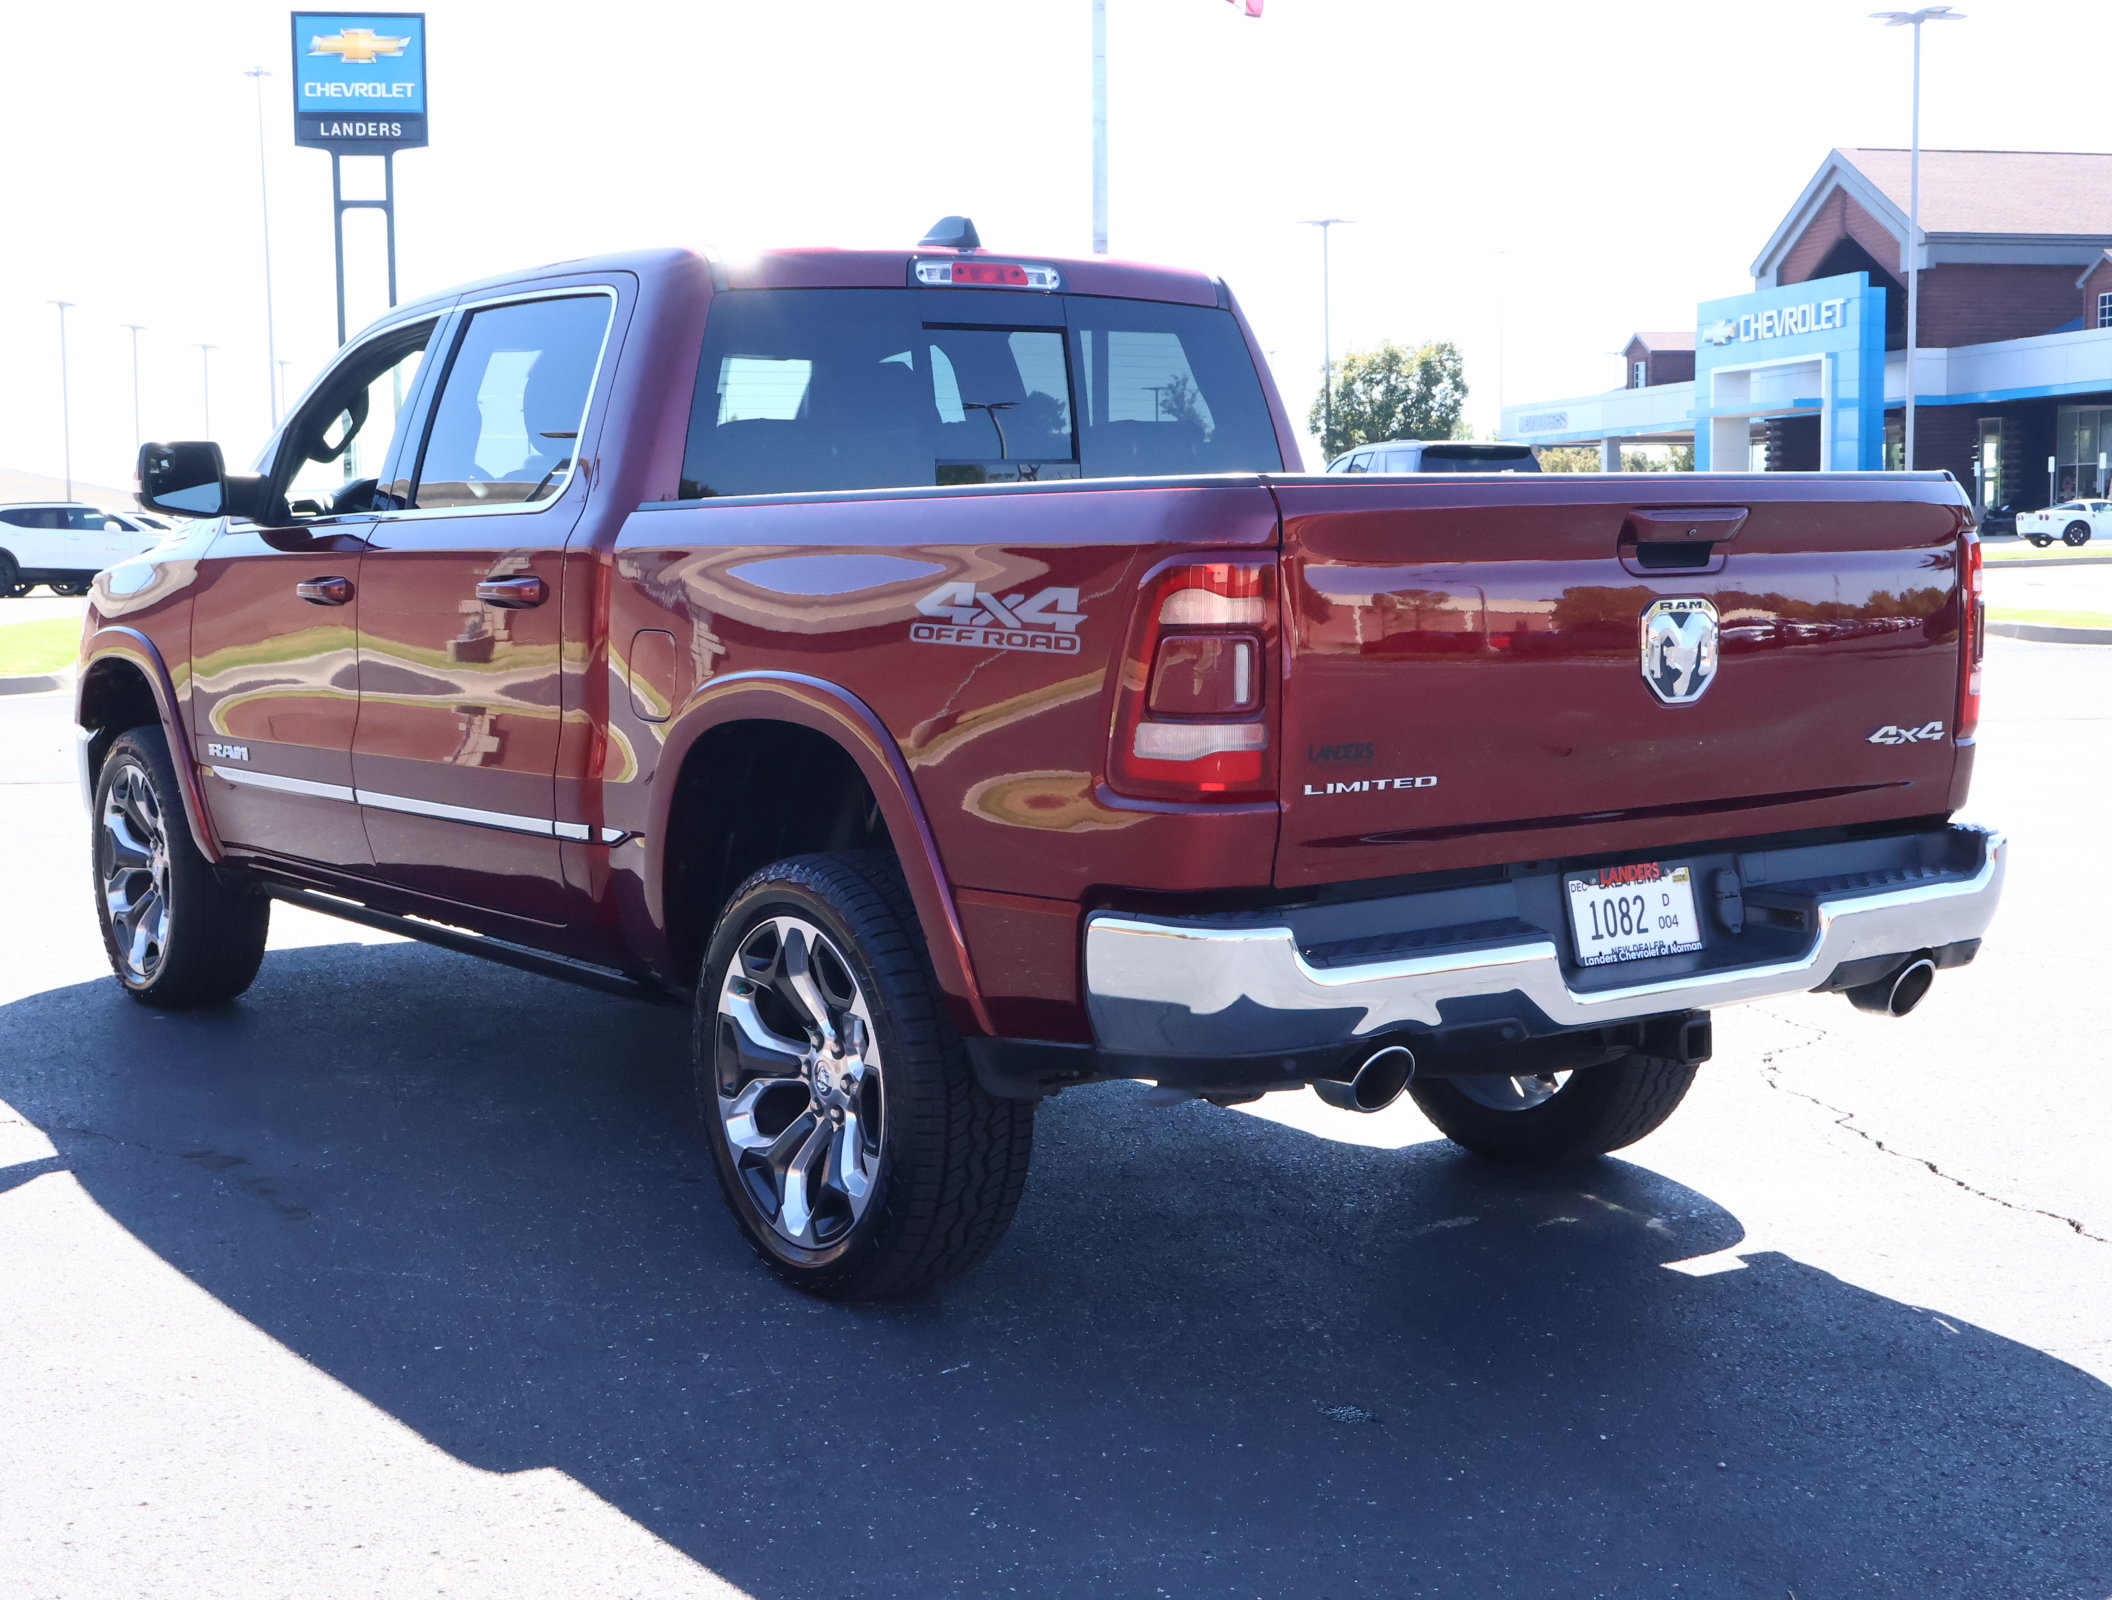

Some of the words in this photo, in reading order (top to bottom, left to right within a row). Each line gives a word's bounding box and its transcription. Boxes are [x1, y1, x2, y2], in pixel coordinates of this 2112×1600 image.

[304, 82, 415, 98] CHEVROLET
[320, 122, 402, 137] LANDERS
[1740, 298, 1846, 342] CHEVROLET
[1659, 601, 1702, 611] RAM
[913, 625, 976, 643] OFF
[982, 630, 1077, 651] ROAD
[208, 743, 249, 761] RAM
[1304, 776, 1438, 796] LIMITED
[1600, 862, 1661, 886] LANDERS
[1570, 883, 1588, 893] DEC
[1661, 893, 1670, 907] D
[1589, 895, 1649, 941] 1082
[1658, 914, 1679, 930] 004
[1584, 953, 1618, 967] Landers
[1618, 946, 1660, 962] Chevrolet
[1660, 944, 1669, 955] of
[1670, 941, 1703, 954] Norman
